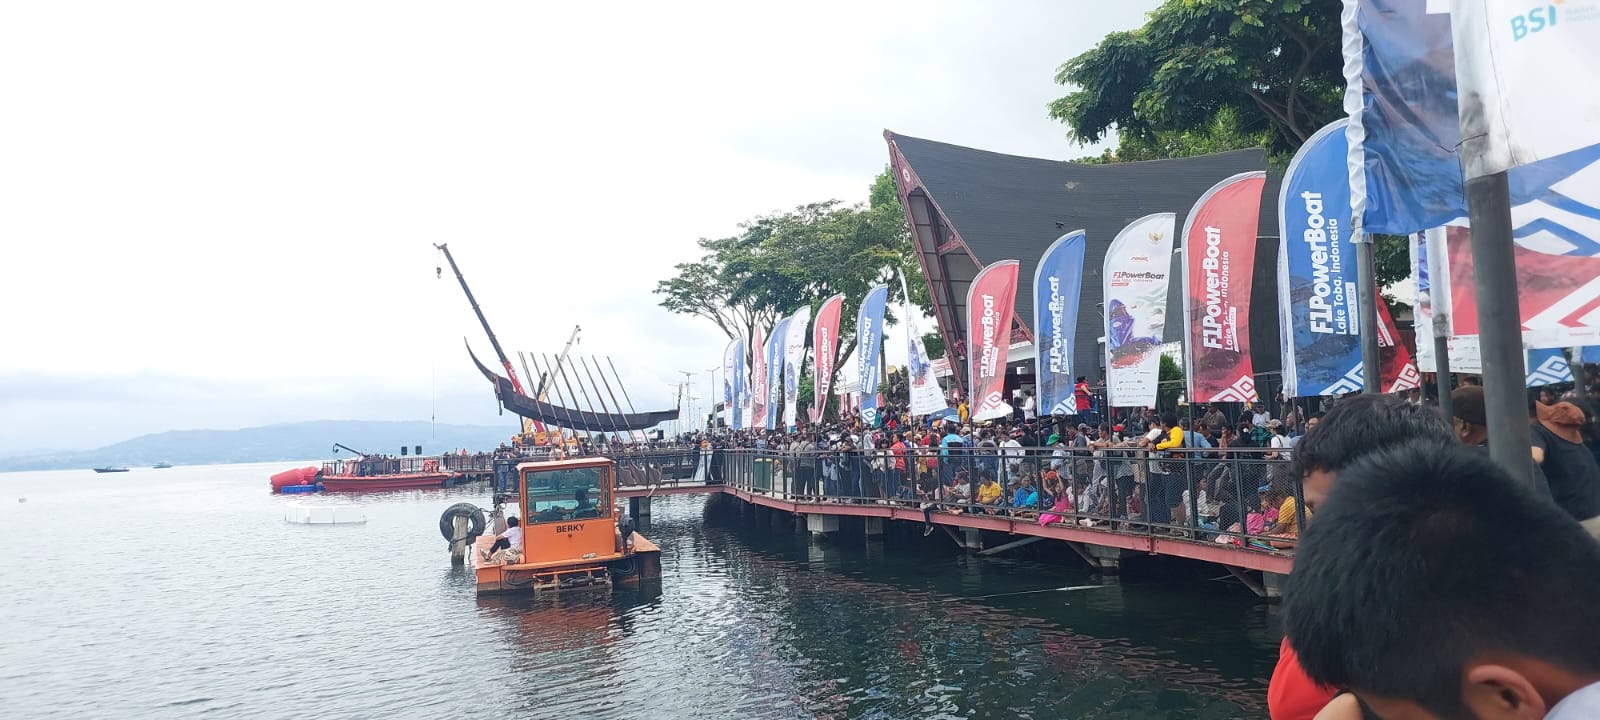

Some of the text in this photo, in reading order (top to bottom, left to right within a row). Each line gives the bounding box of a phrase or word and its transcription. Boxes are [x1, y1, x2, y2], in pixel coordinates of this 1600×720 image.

[1511, 4, 1557, 41] BSI
[1113, 271, 1165, 280] F1PowerBoat
[1202, 225, 1222, 350] F1PowerBoat
[1301, 190, 1334, 334] F1PowerBoat
[1327, 218, 1347, 335] Lake Toba, Indonesia
[1048, 276, 1062, 373] F1PowerBoat
[556, 523, 585, 533] BERKY
